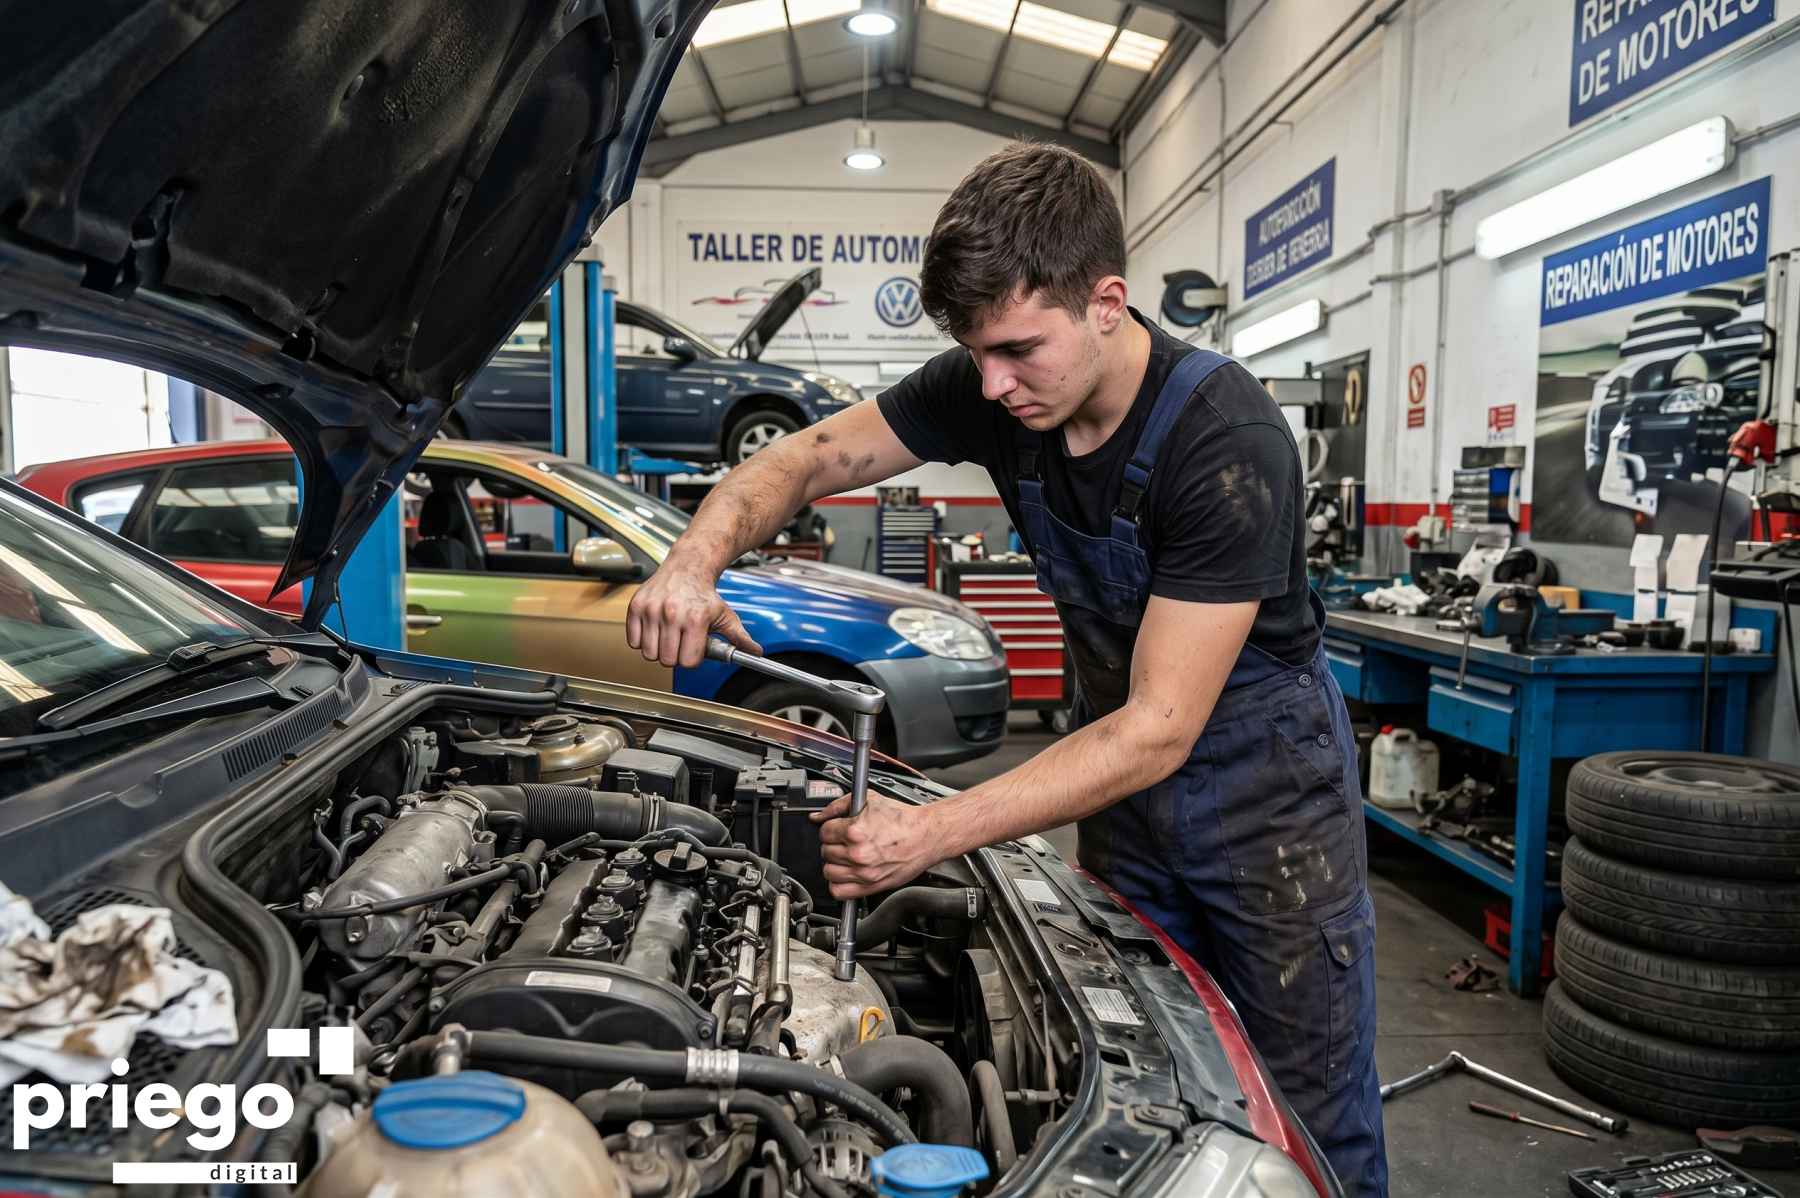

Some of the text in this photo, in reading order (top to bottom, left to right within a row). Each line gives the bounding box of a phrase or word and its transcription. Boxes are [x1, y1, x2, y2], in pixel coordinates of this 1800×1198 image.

[1578, 0, 1760, 105] DE MOTORE
[688, 233, 929, 264] TALLER DE AUTOM
[1545, 202, 1759, 310] REPARACIÓN DE MOTORES
